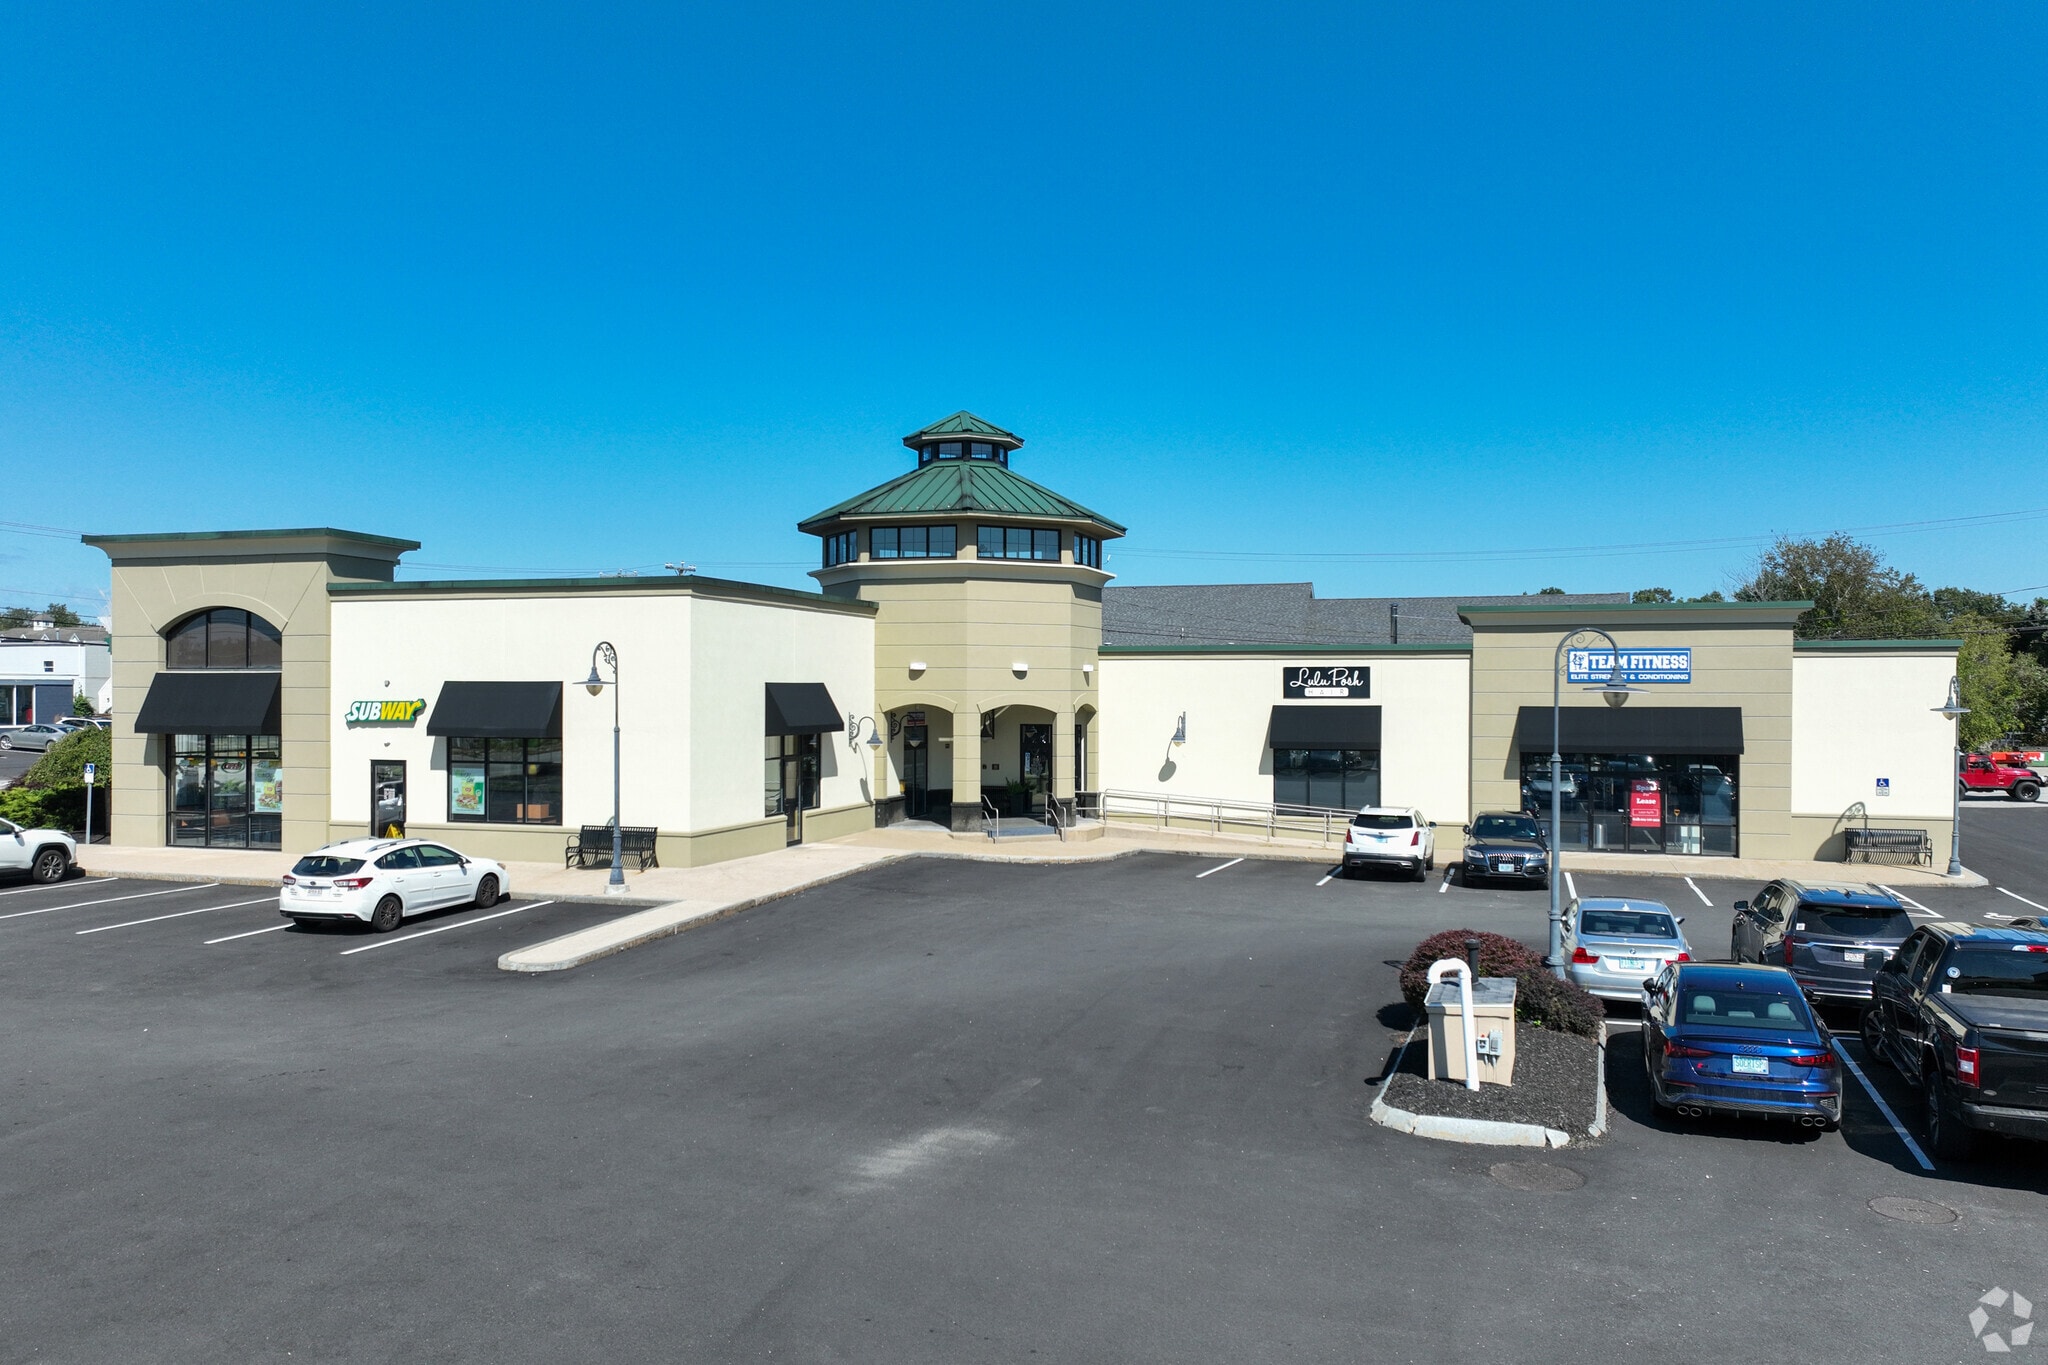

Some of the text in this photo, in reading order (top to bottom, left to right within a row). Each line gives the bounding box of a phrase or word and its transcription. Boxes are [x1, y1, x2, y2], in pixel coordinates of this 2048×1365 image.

[1589, 655, 1688, 669] TEAM FITNESS
[1290, 668, 1364, 687] Lulu Posh
[346, 701, 422, 721] SUBWAY
